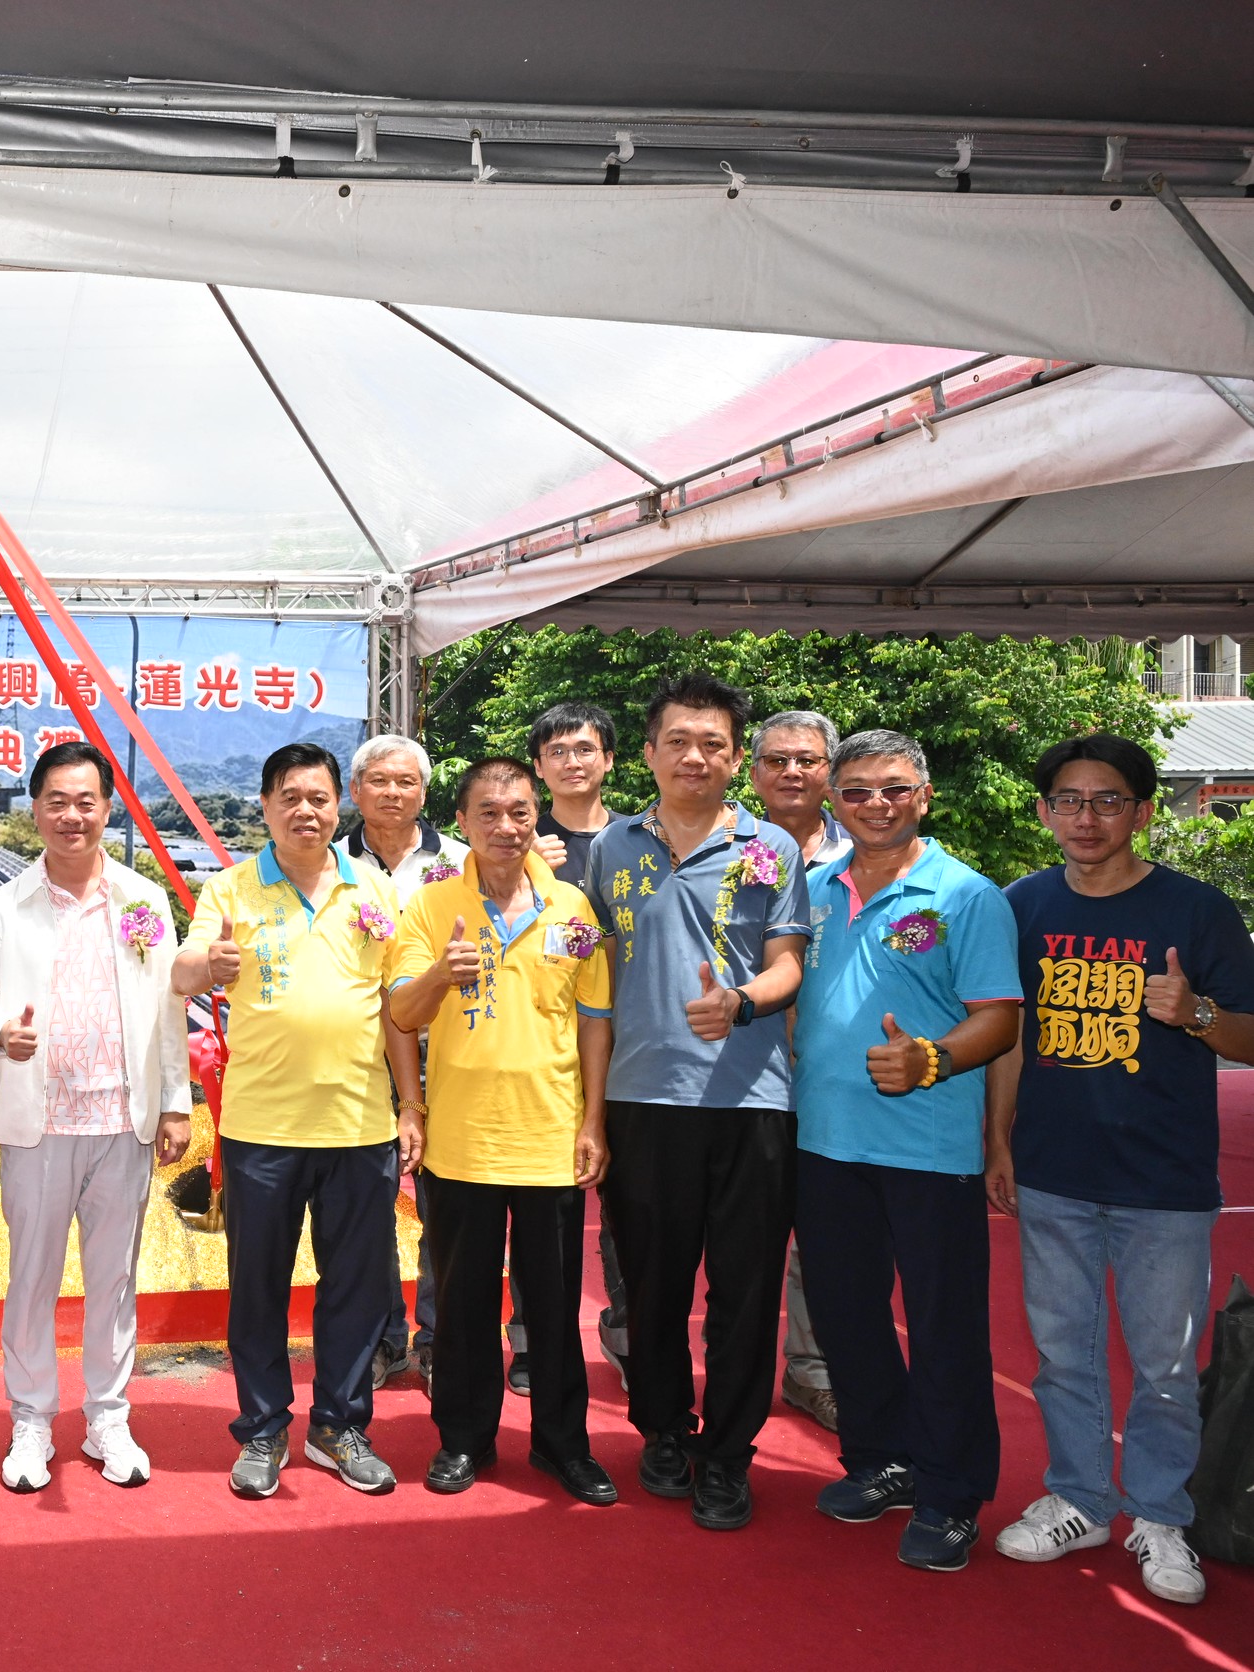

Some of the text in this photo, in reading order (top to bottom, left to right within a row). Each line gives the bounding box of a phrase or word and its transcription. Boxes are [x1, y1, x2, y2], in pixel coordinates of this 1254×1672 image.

[638, 853, 658, 897] 代表
[1043, 934, 1146, 963] YI LAN
[478, 926, 497, 1019] 頭城鎮民代表
